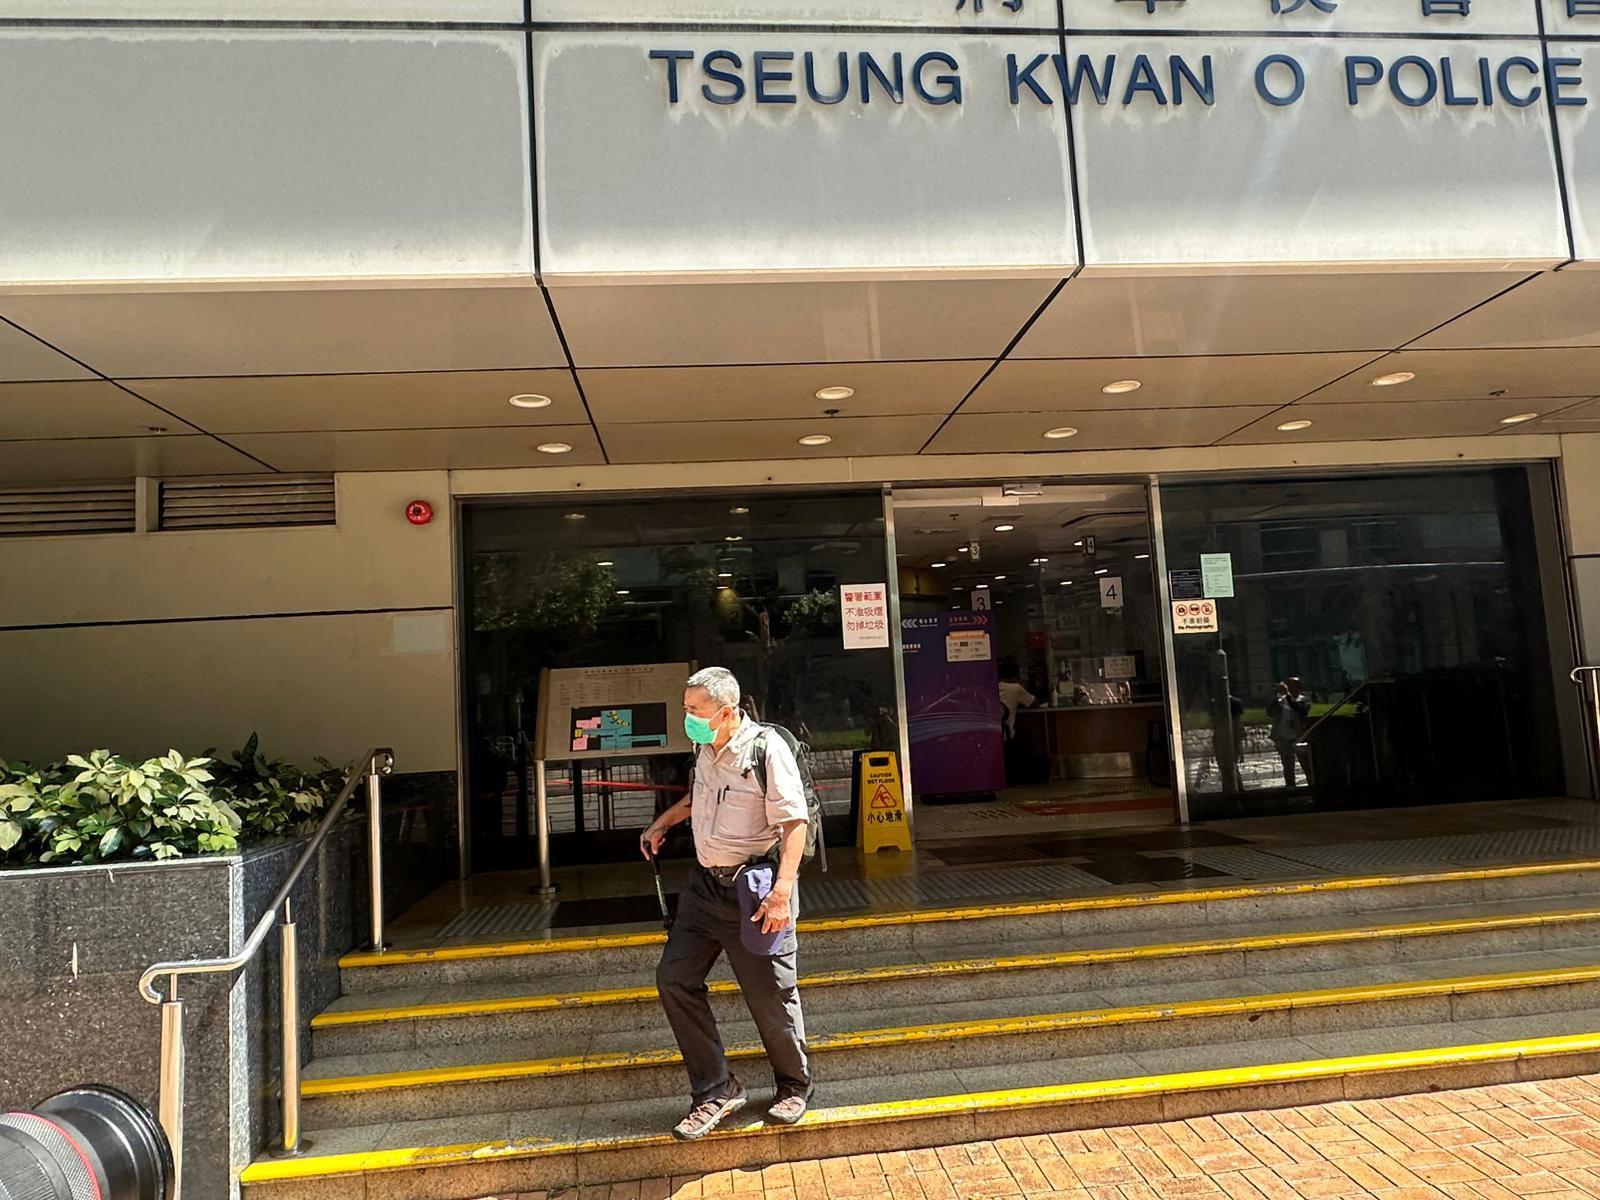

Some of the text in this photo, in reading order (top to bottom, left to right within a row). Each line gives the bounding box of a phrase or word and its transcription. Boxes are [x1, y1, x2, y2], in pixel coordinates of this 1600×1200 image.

[649, 50, 1588, 107] TSEUNG KWAN O POLICE
[1105, 584, 1117, 600] 4
[867, 809, 903, 825] 小心地滑
